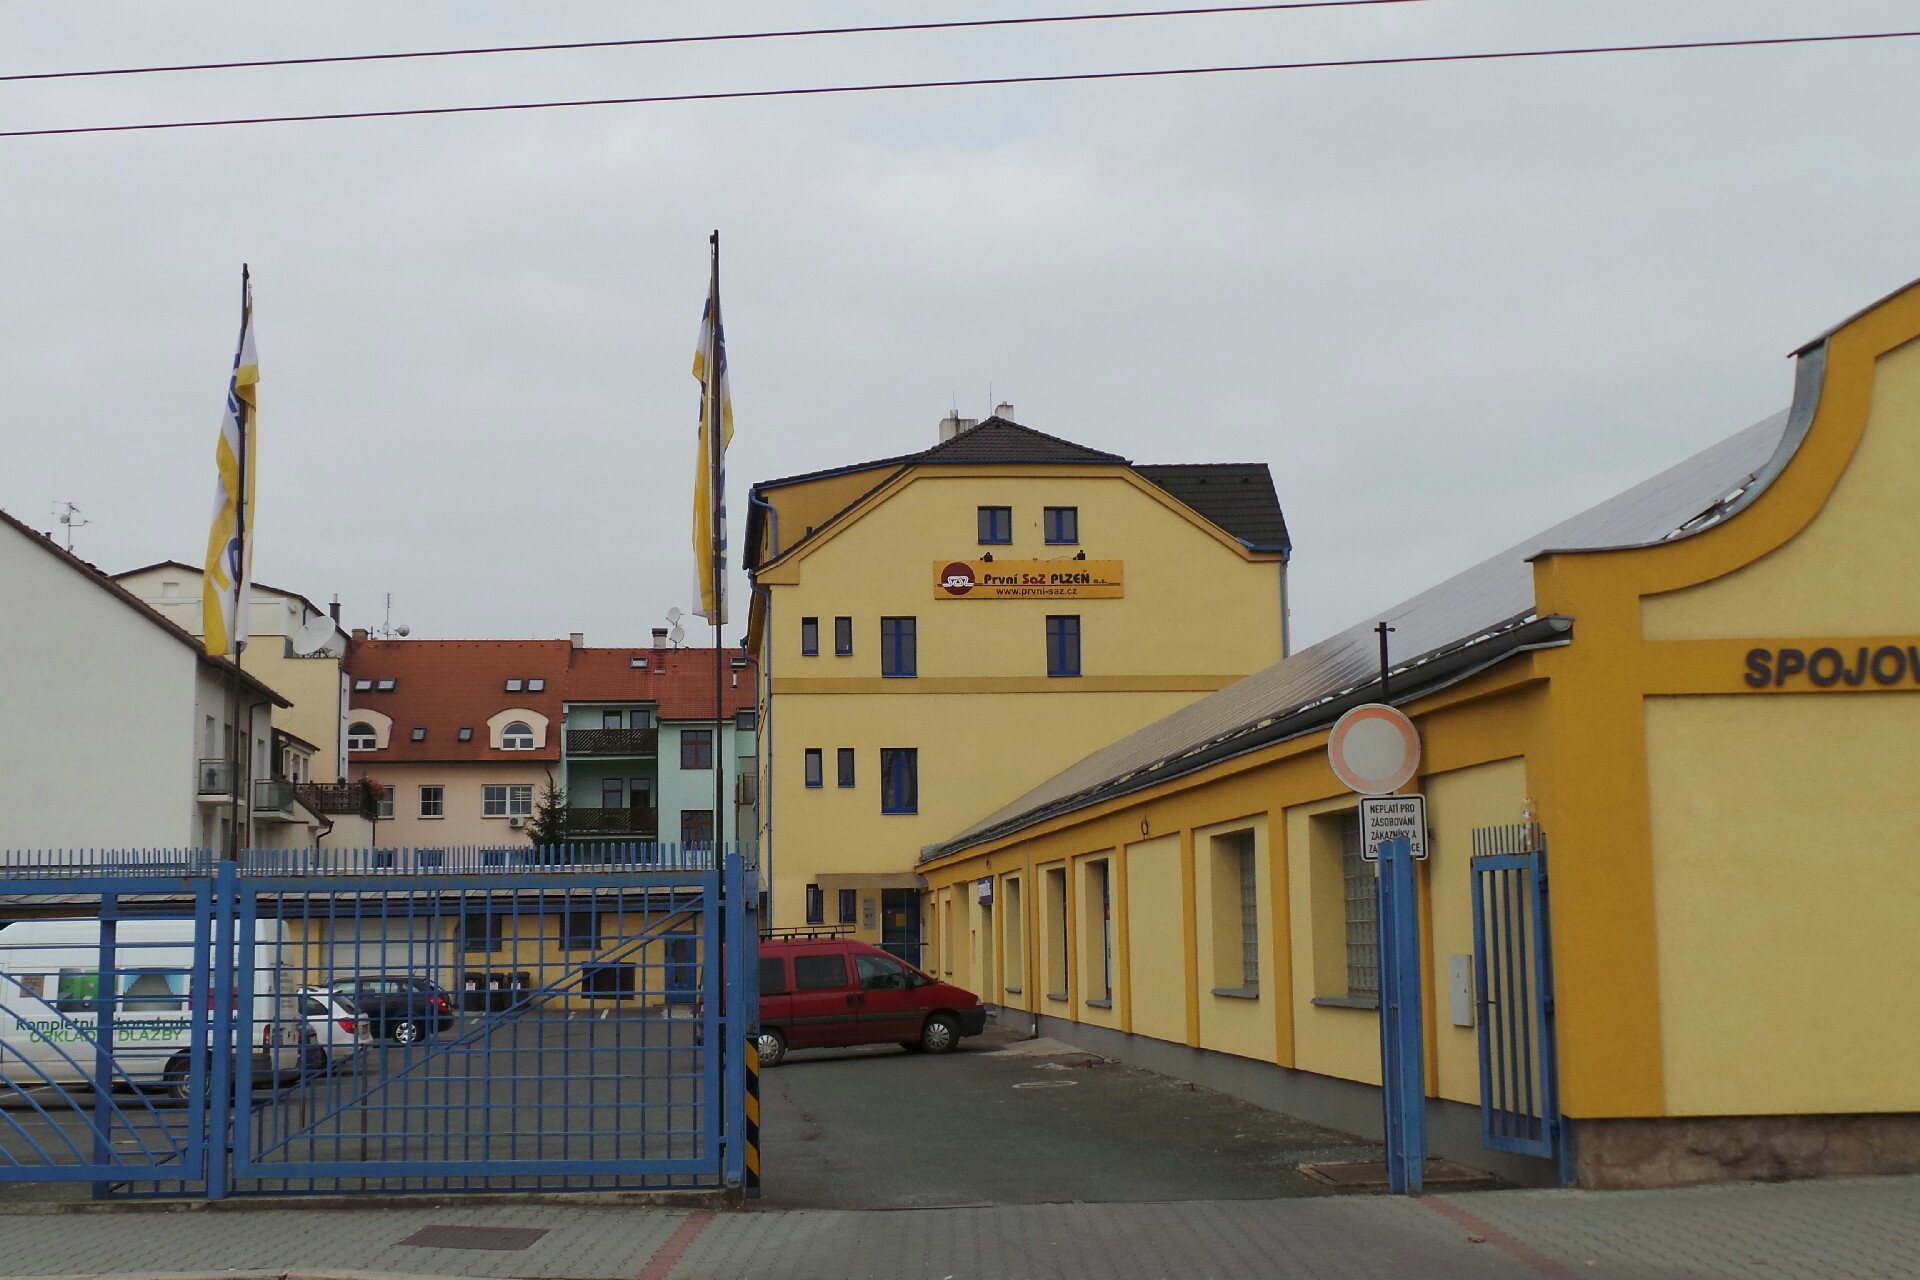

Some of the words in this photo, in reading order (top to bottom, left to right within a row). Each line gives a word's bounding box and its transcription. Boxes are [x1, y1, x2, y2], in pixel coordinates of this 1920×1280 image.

[983, 573, 1018, 585] První
[1022, 573, 1046, 585] SaZ
[1050, 569, 1090, 585] PLZEŇ
[995, 586, 1078, 597] www.prvni-saz.cz
[1370, 803, 1399, 813] NEPLATÍ
[1400, 803, 1415, 813] PRO
[1371, 816, 1415, 827] ZÁSOBOVÁNÍ
[1412, 830, 1417, 839] A
[15, 1016, 95, 1033] Kompletní
[29, 1030, 97, 1043] OBKLAD
